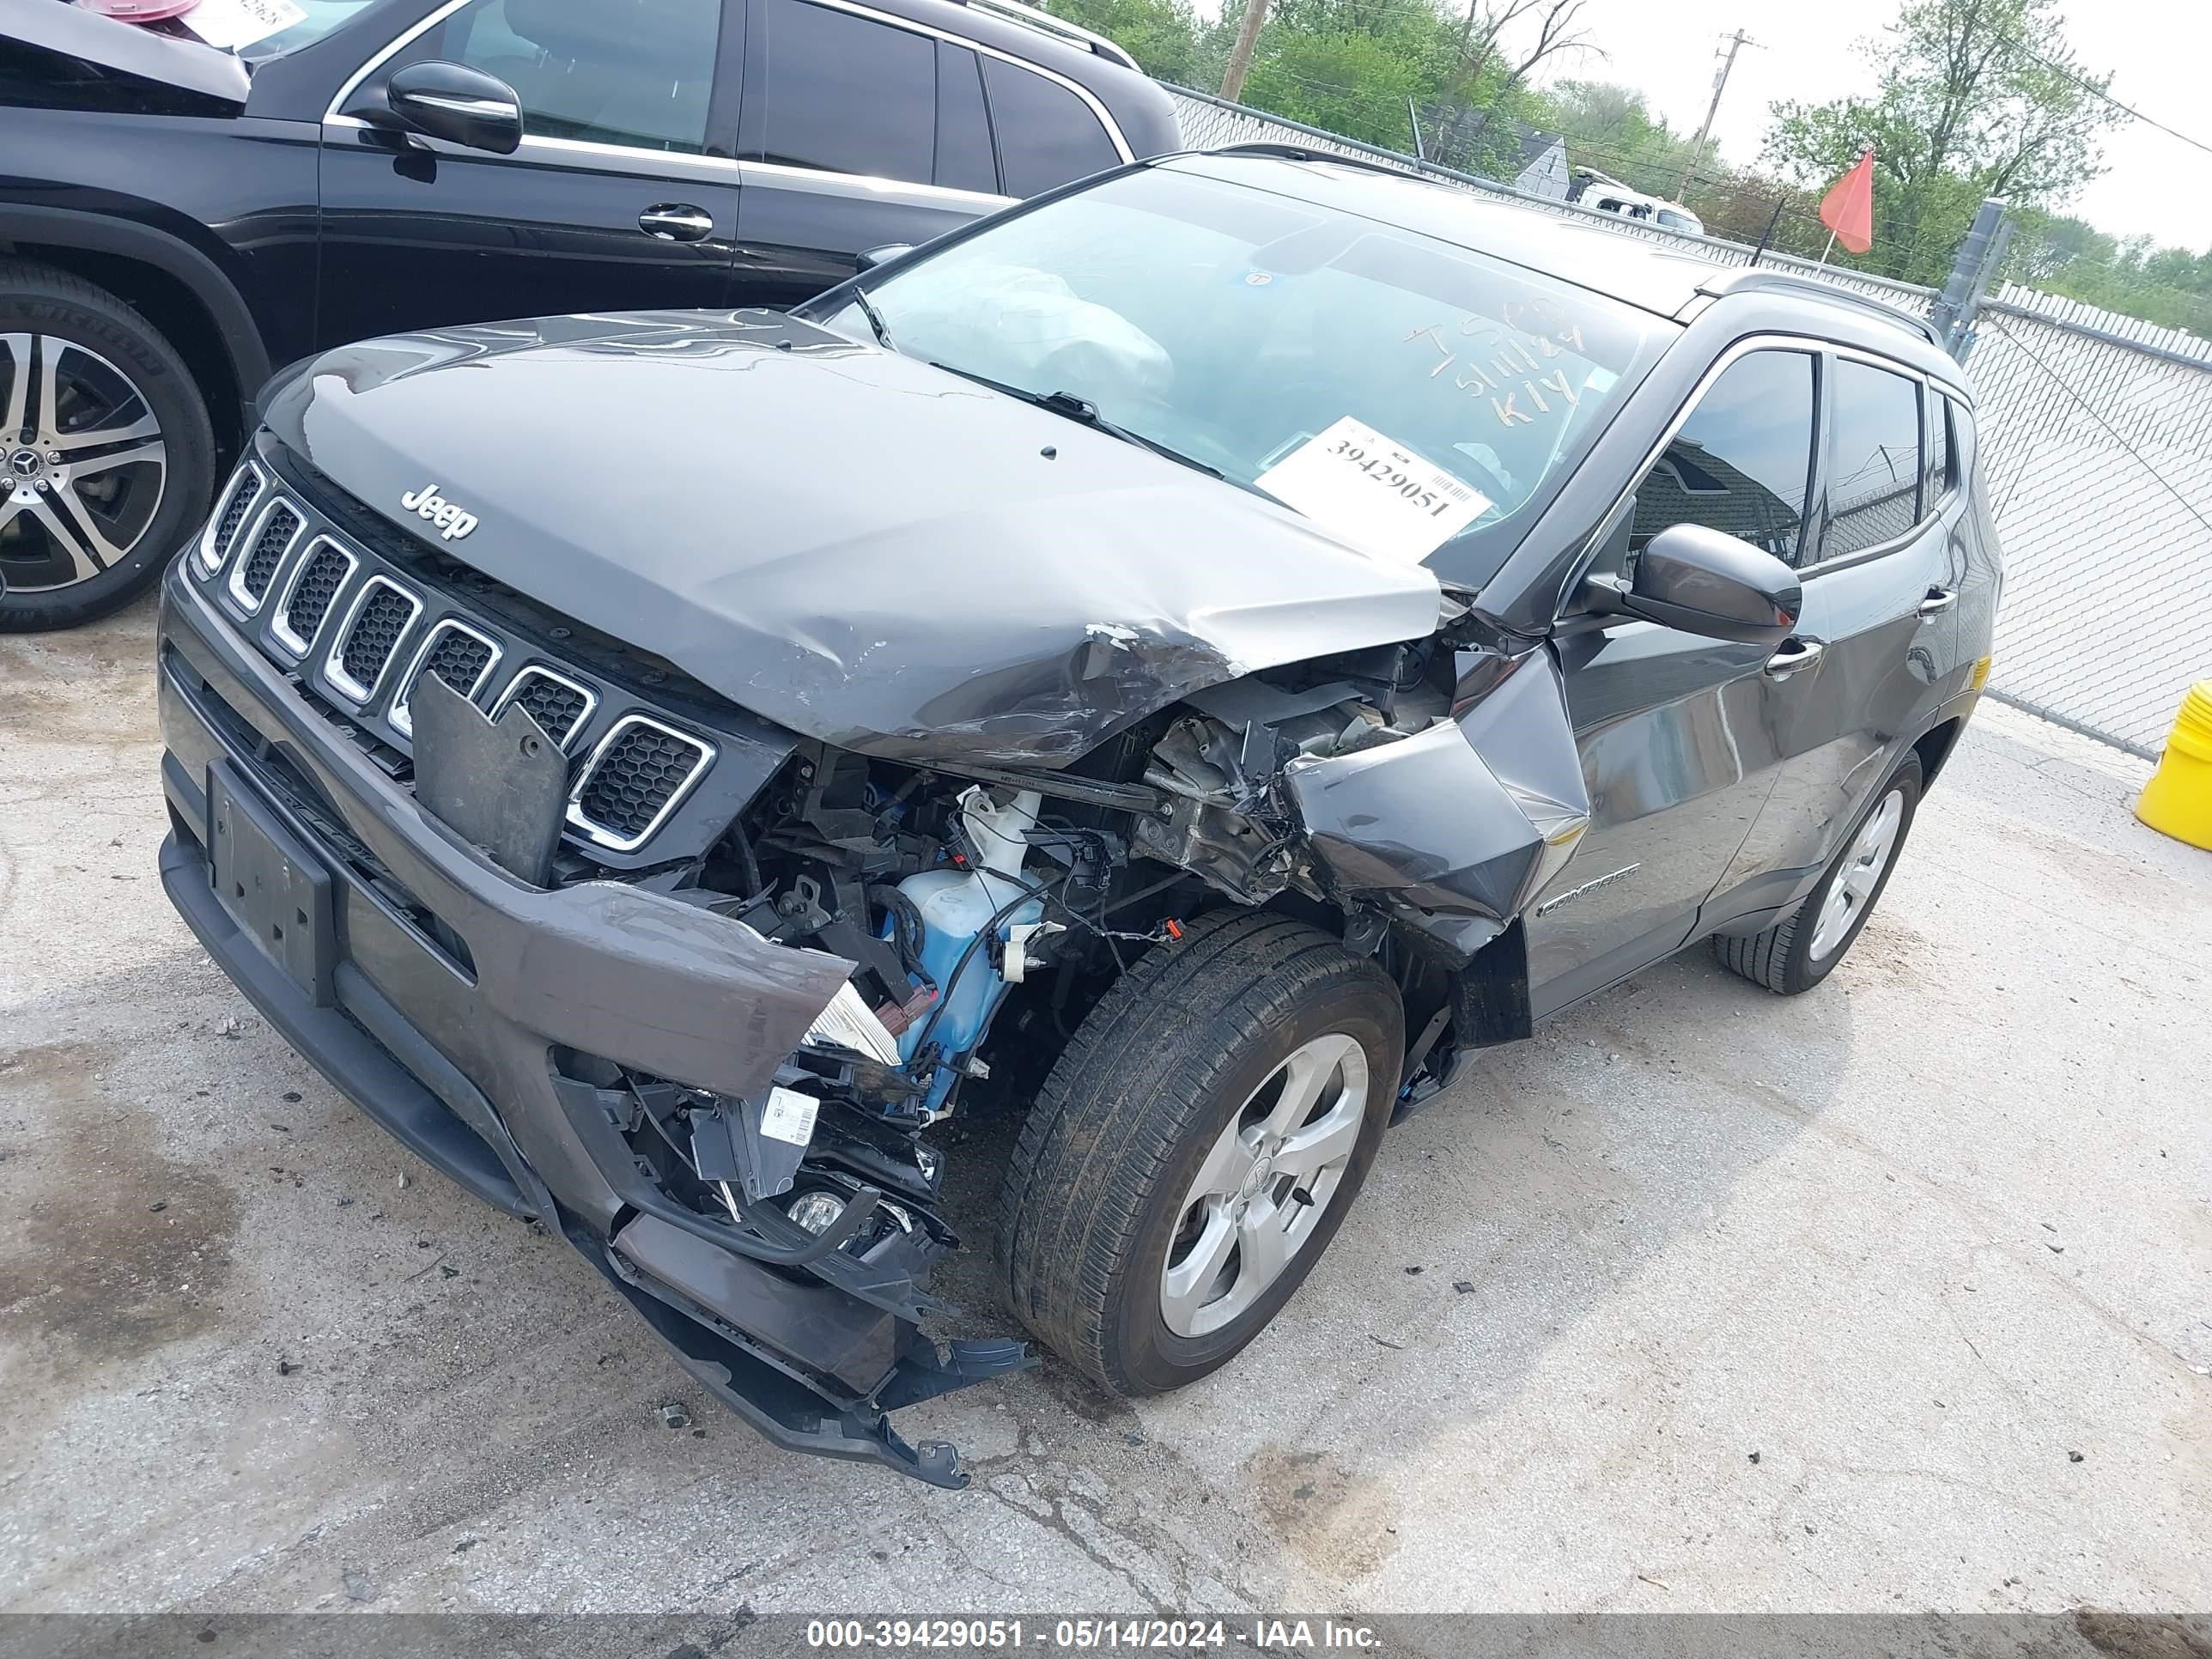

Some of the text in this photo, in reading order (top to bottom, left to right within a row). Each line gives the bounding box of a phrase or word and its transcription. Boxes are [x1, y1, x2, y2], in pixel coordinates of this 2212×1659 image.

[1328, 440, 1450, 517] 39429051
[401, 483, 479, 541] Jeep
[1540, 862, 1641, 916] COMPASS
